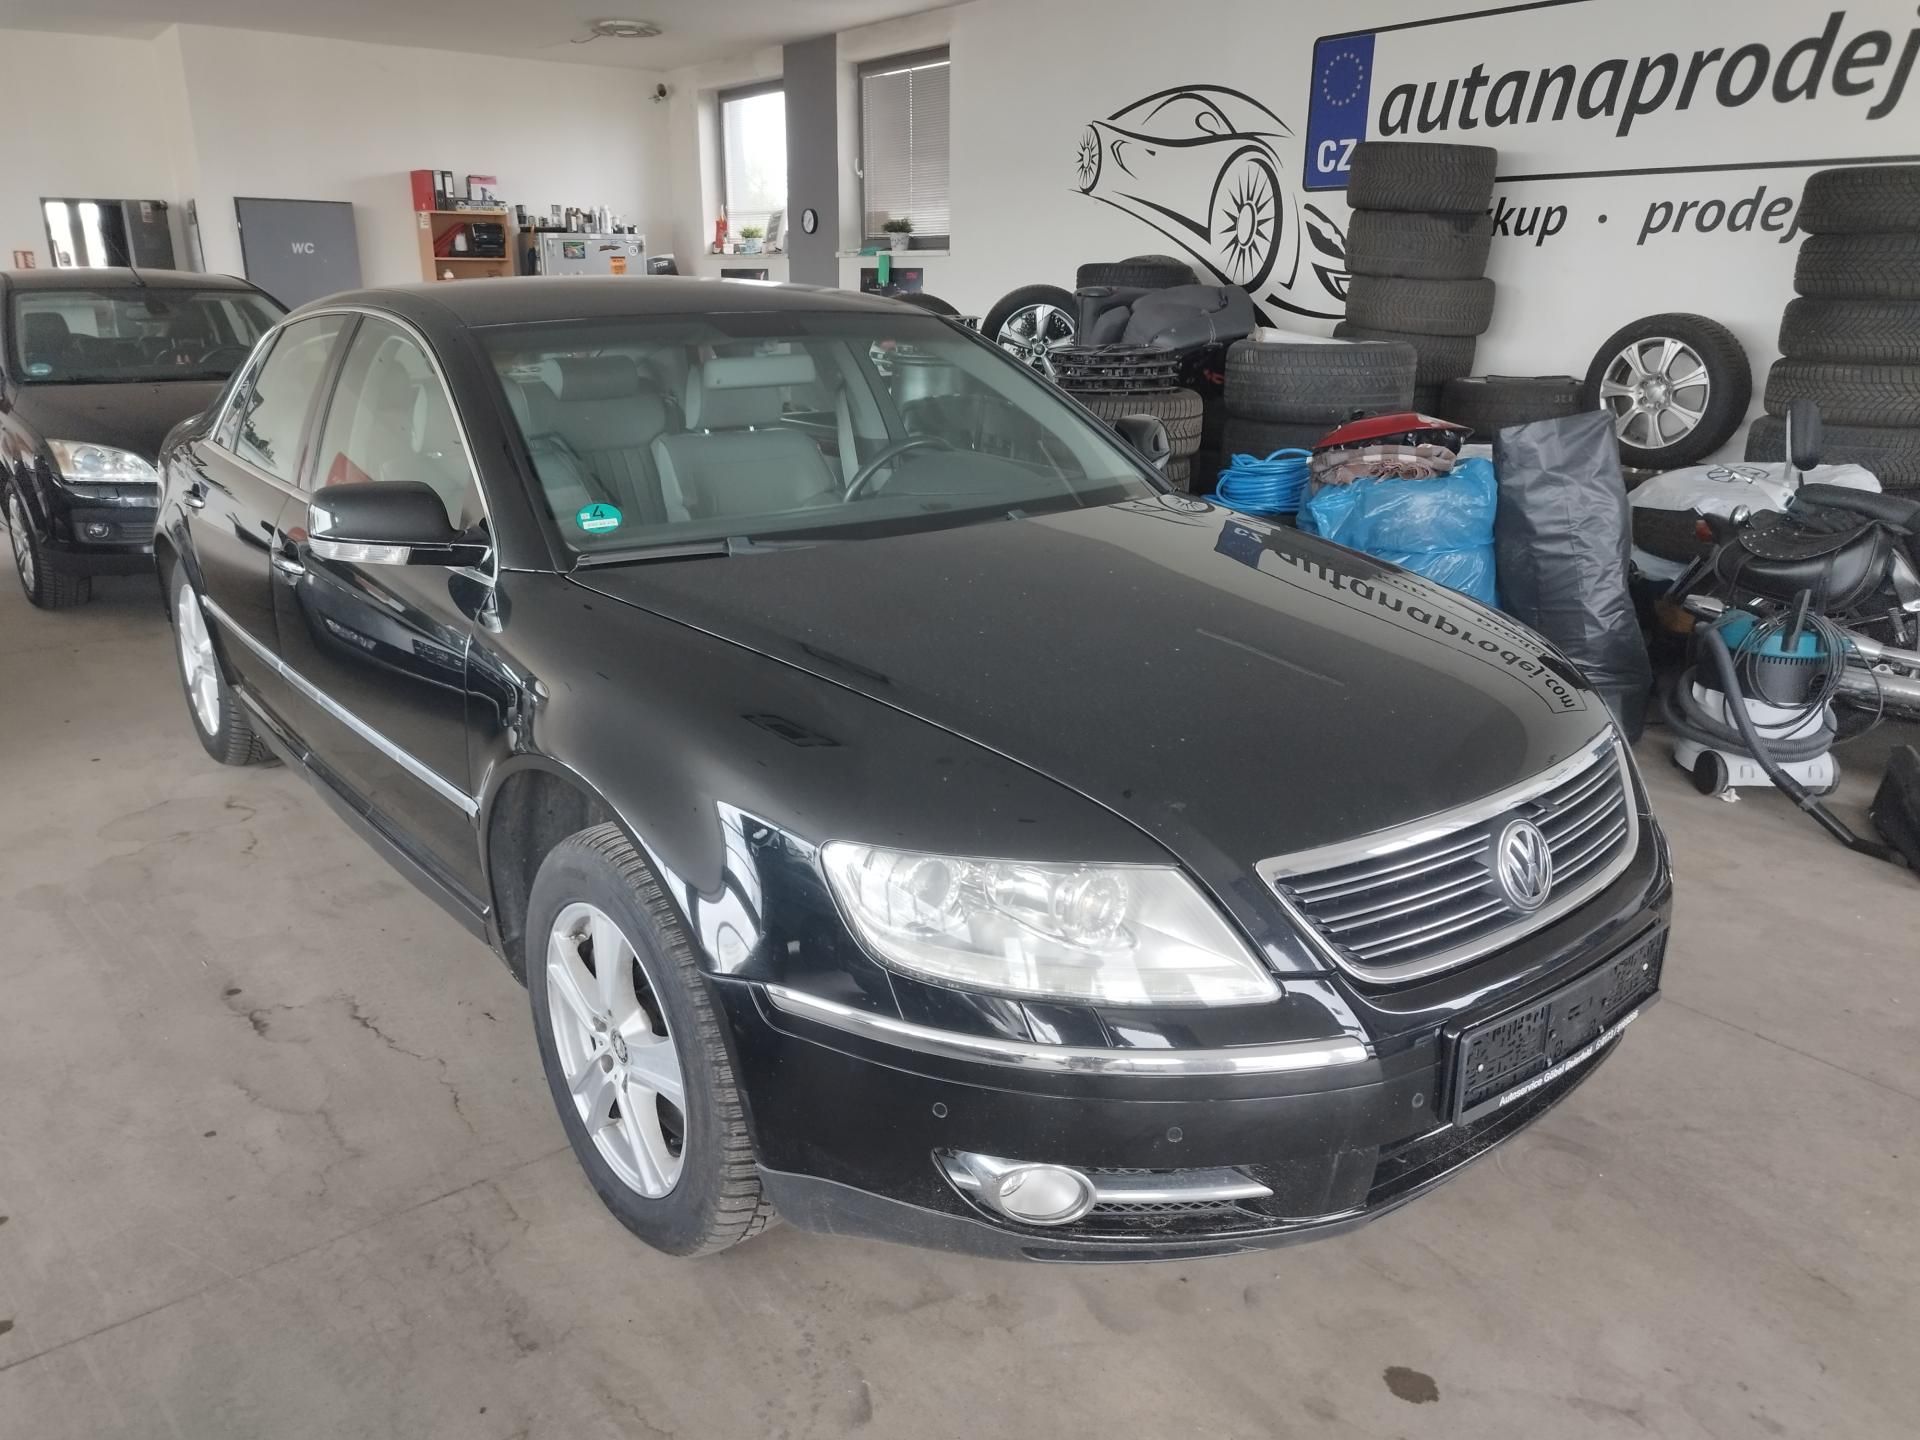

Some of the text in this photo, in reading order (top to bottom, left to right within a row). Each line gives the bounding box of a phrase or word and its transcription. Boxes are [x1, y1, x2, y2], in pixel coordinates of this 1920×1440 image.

[1379, 5, 1920, 137] autanaprodej
[1317, 139, 1357, 173] CZ
[1487, 196, 1568, 247] kup
[291, 242, 315, 254] WC
[592, 505, 605, 518] 4
[1498, 1077, 1543, 1107] Autoservice
